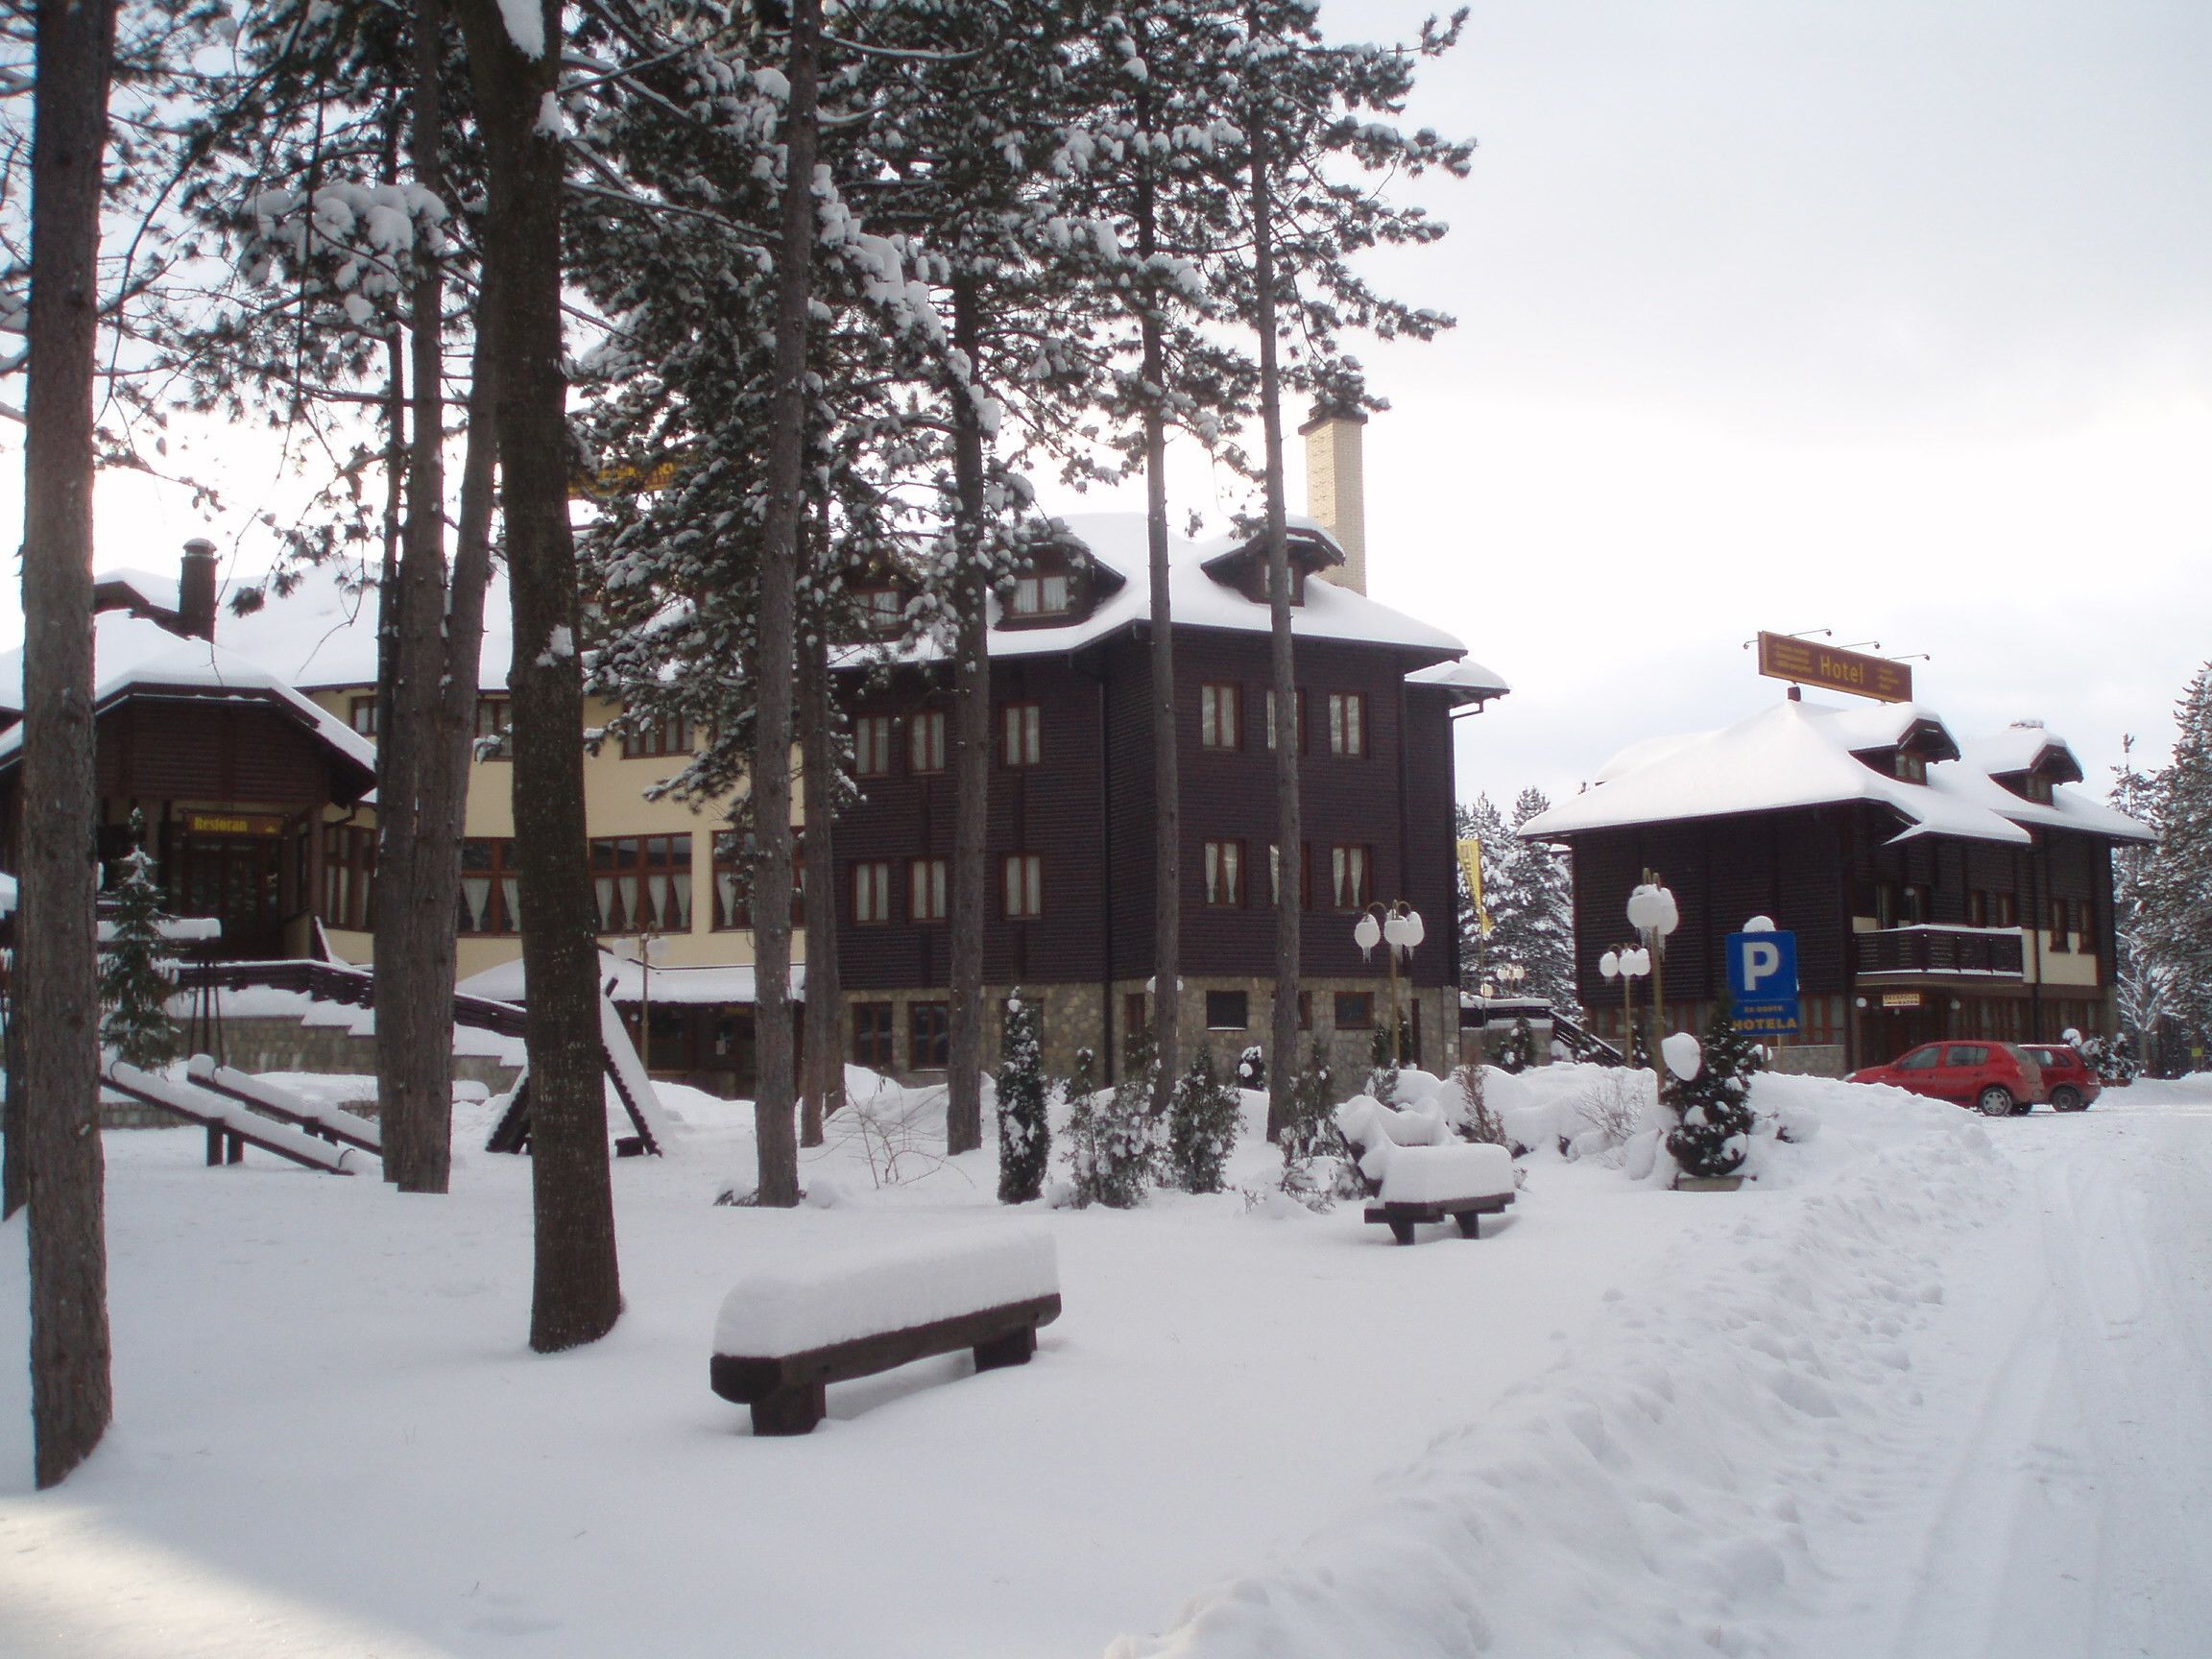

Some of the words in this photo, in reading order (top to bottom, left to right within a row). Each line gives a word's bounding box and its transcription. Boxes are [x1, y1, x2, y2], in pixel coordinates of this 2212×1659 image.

[1820, 655, 1863, 685] Hotel
[194, 817, 248, 831] Restoran
[1743, 942, 1779, 991] P
[1732, 1019, 1797, 1030] HOTELA
